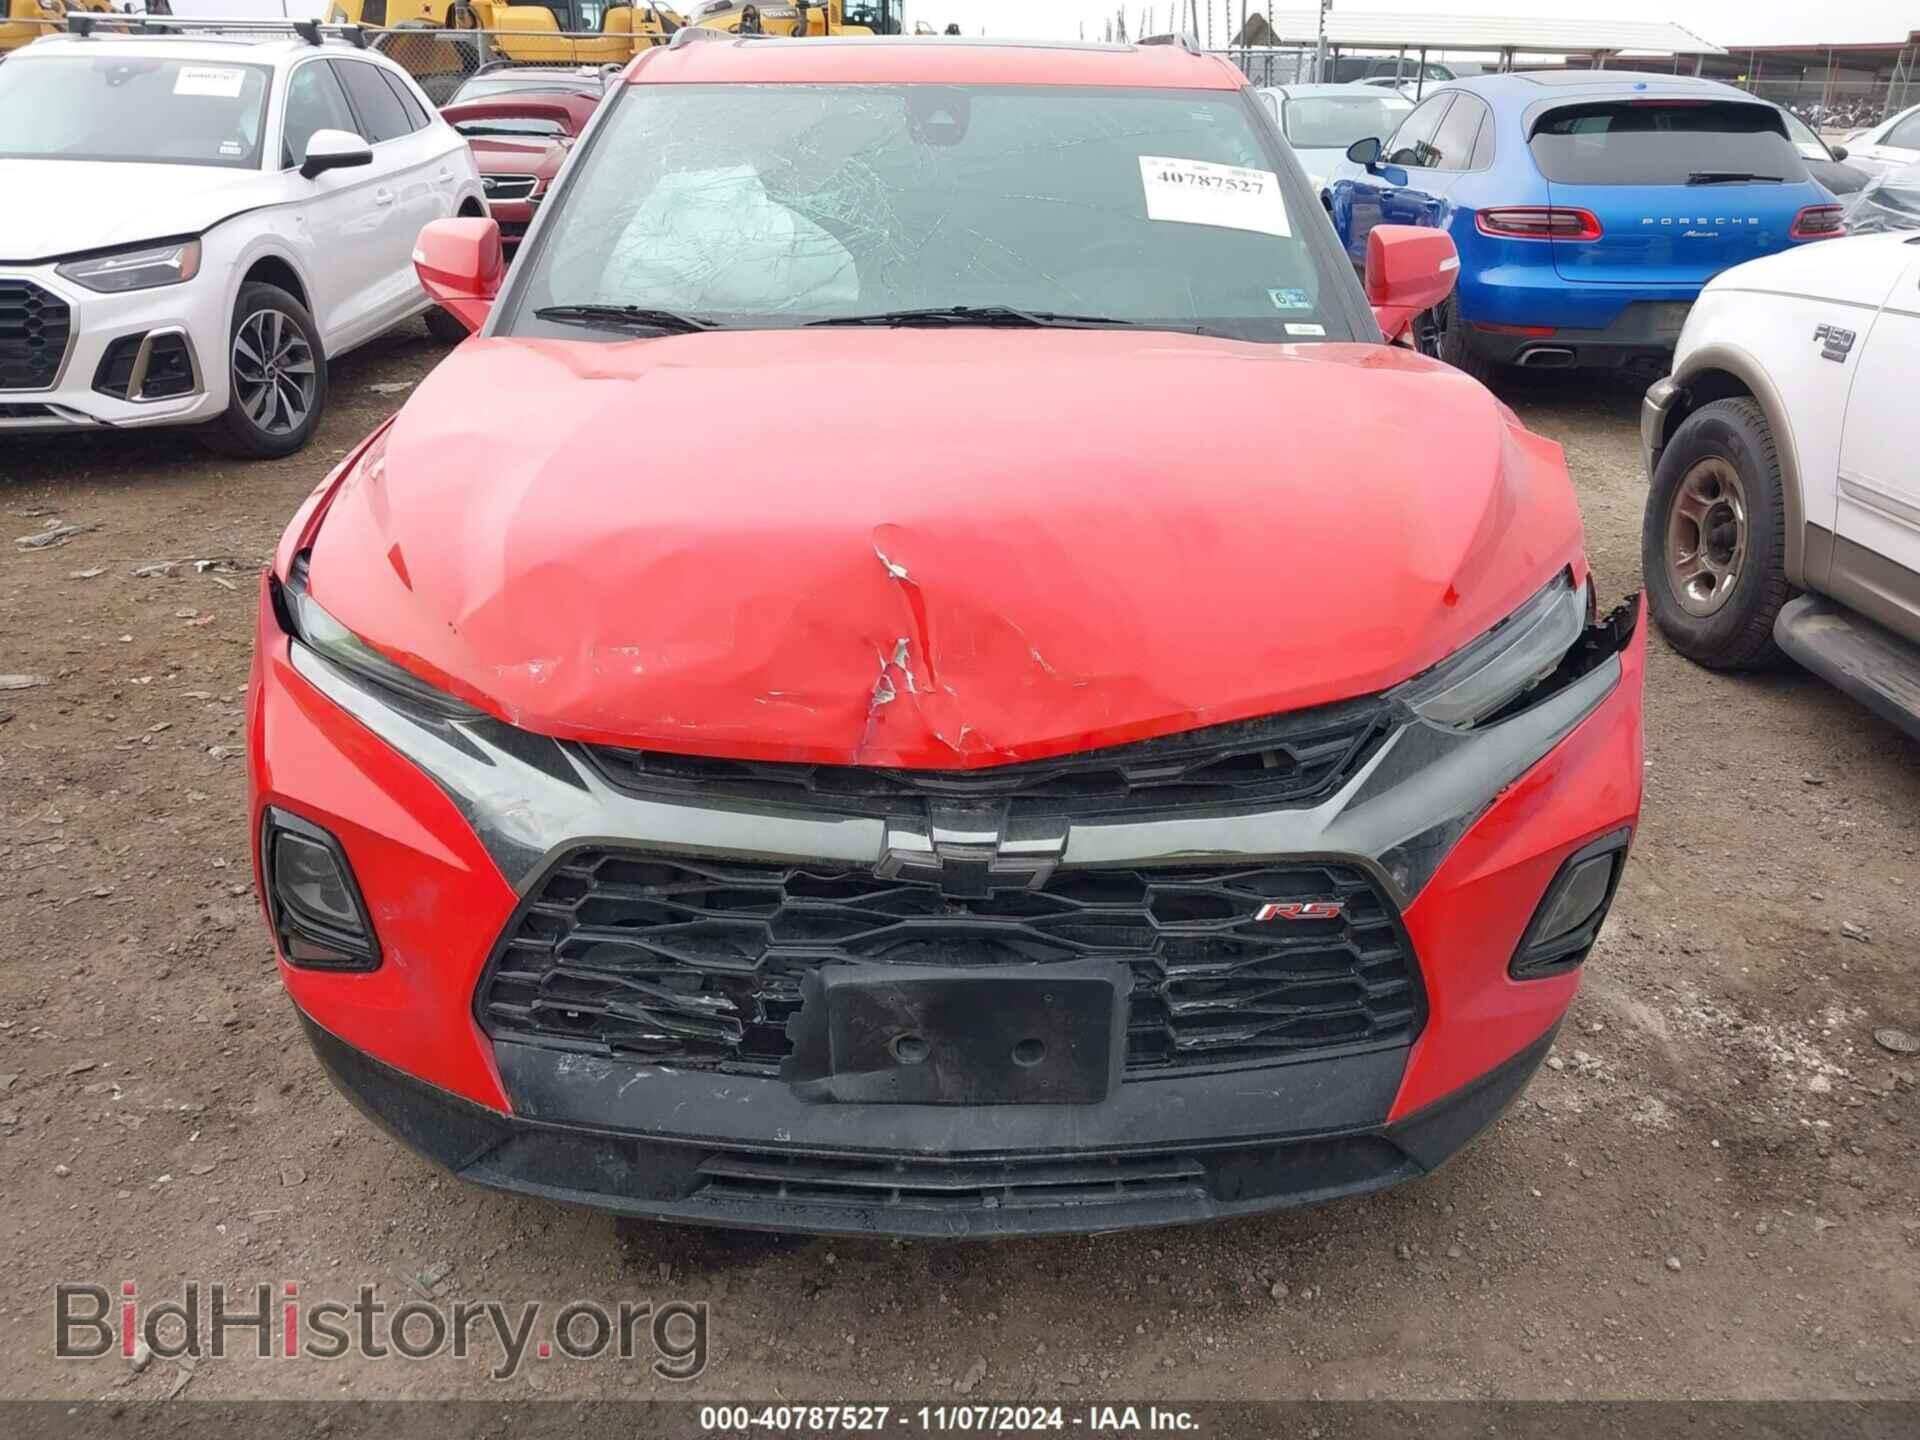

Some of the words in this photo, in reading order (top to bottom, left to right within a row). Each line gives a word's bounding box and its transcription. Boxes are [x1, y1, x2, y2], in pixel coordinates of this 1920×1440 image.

[1157, 171, 1264, 195] 40787527
[1642, 217, 1759, 225] PORSCHE
[1255, 902, 1345, 921] RS
